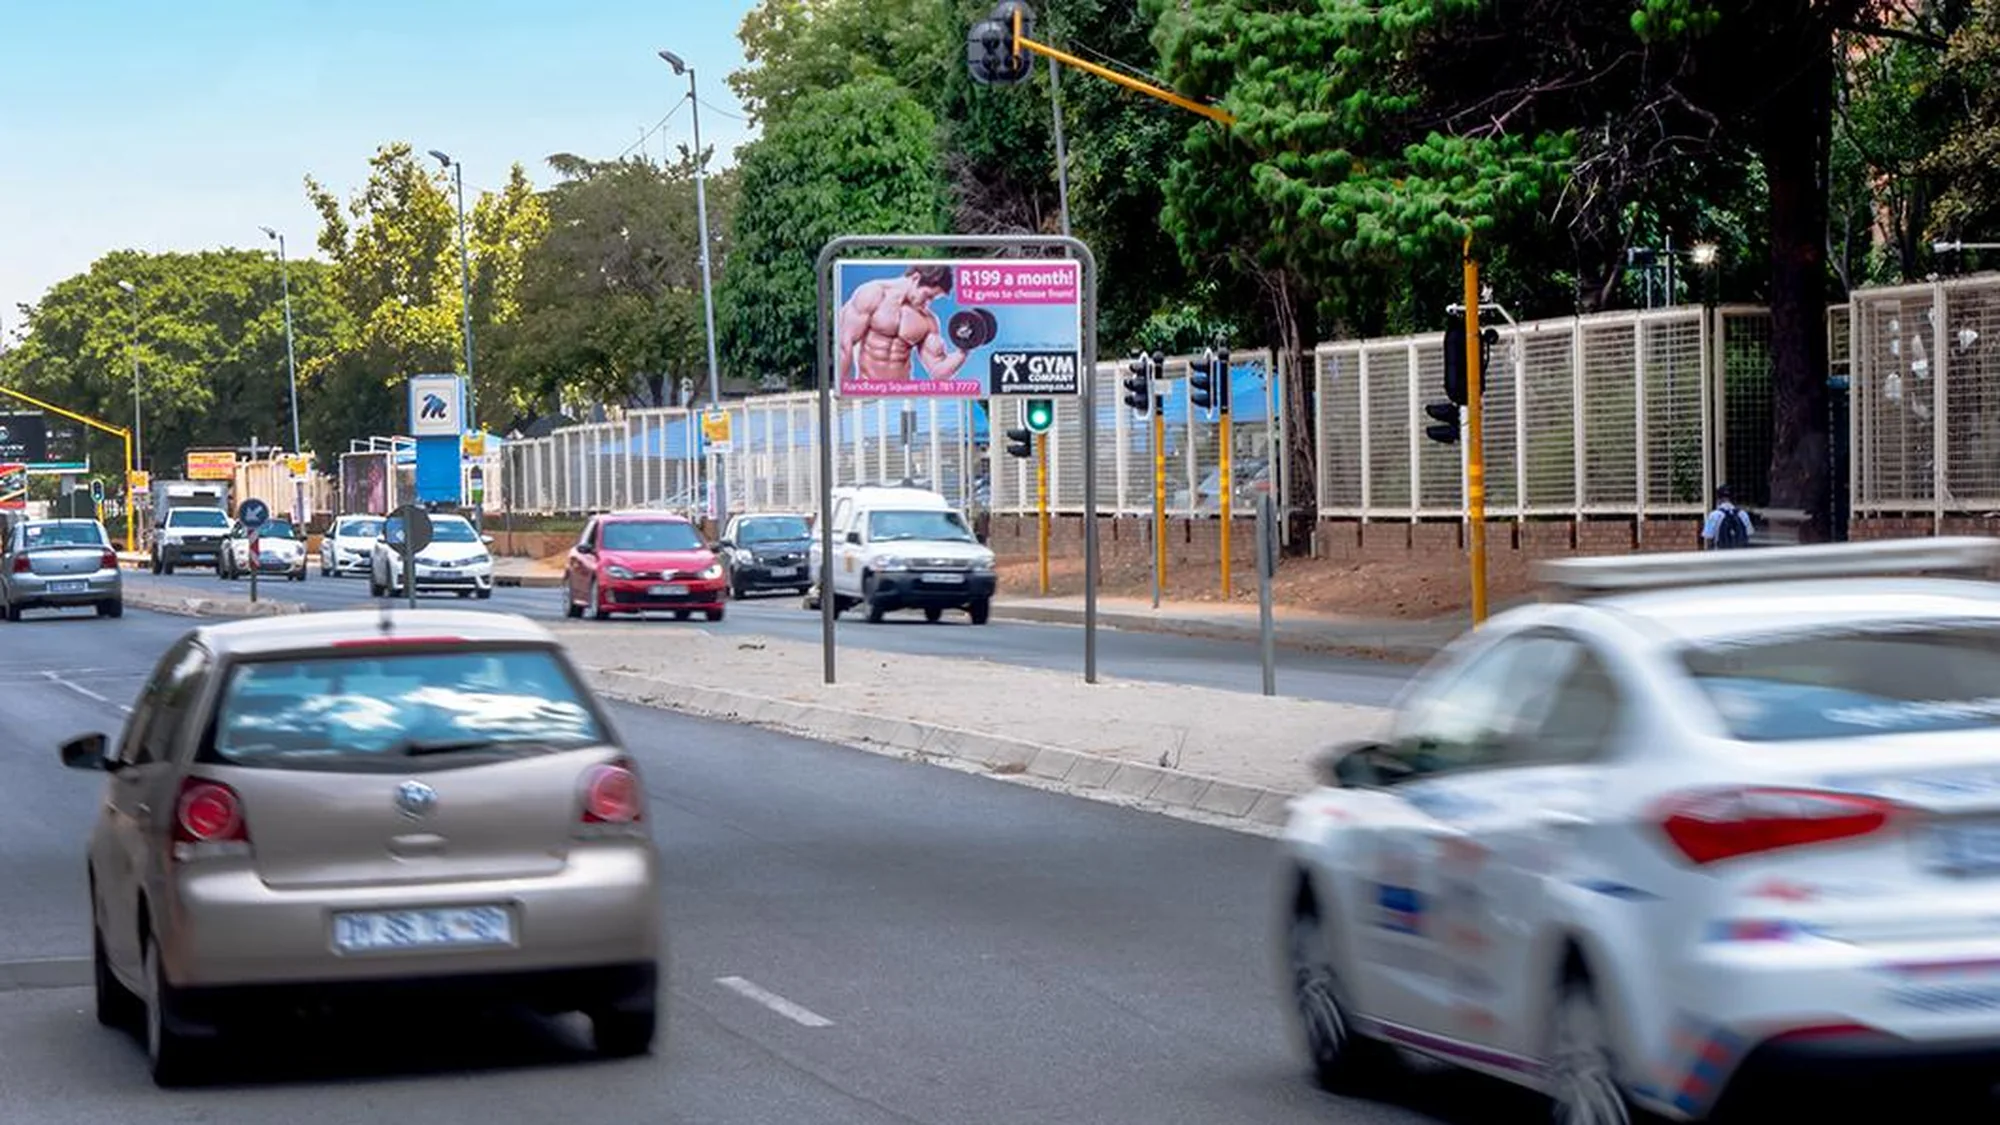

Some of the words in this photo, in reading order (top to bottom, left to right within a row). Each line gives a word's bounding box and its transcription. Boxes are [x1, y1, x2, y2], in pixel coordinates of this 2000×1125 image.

[961, 270, 1000, 286] R199
[1004, 273, 1013, 285] a
[1017, 270, 1074, 285] month!
[963, 289, 973, 298] 12
[975, 291, 1000, 301] gyms
[1002, 289, 1012, 298] to
[1014, 289, 1046, 298] choose
[1028, 355, 1074, 373] GYM
[1028, 374, 1074, 382] COMPANY
[843, 382, 887, 392] Randburg
[889, 382, 917, 392] Square
